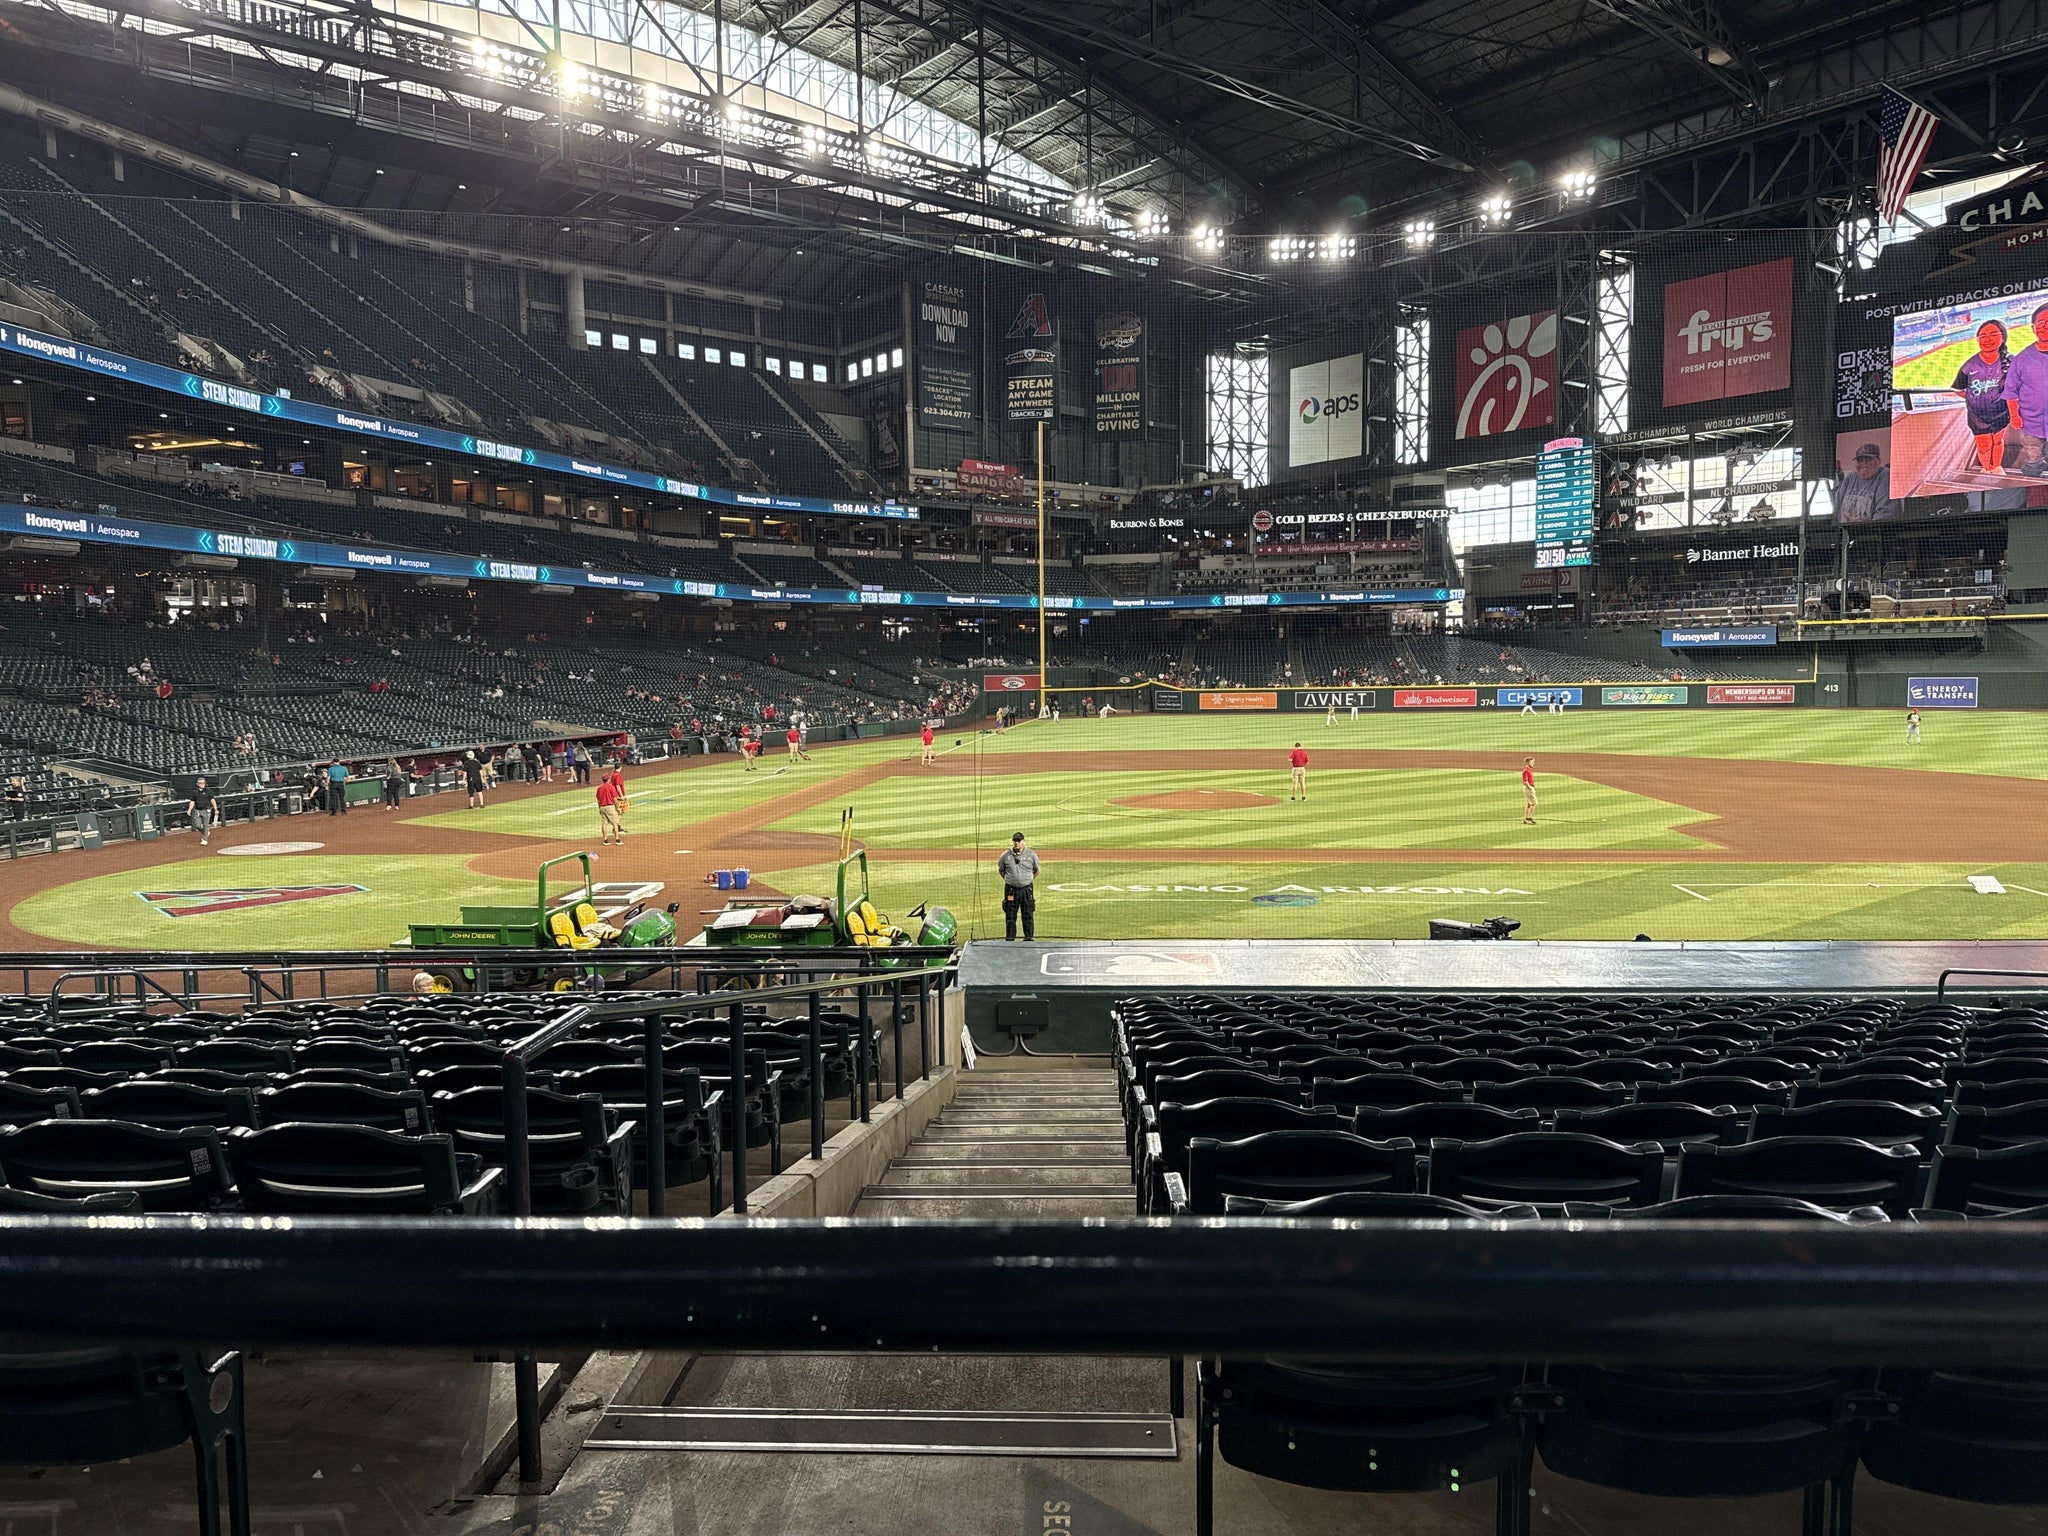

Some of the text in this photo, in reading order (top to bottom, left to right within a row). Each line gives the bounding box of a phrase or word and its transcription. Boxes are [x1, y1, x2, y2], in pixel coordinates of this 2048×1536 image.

[925, 282, 965, 298] CAESARS
[1866, 305, 1898, 320] POST
[1901, 299, 1932, 313] WITH
[1936, 287, 1999, 306] #DBACKS
[2003, 282, 2023, 294] ON
[922, 303, 969, 328] DOWNLOAD
[1701, 313, 1767, 331] FOOD STORES
[935, 324, 956, 343] NOW
[16, 332, 127, 373] Honeywell Aerospace
[1096, 357, 1140, 365] CELEBRATING
[1680, 352, 1771, 374] FRESH FOR EVERYONE
[1008, 379, 1053, 390] STREAM
[202, 380, 261, 412] STEM SUNDAY
[933, 394, 962, 402] LOCATION
[1008, 390, 1053, 400] ANY GAME
[1096, 392, 1140, 403] MILLION
[1008, 400, 1053, 408] ANYWHERE
[1323, 393, 1359, 418] aps
[923, 407, 971, 418] 623.304.0777
[1096, 411, 1140, 420] CHARITABLE
[337, 414, 419, 439] Honeywell Aerospace
[1096, 420, 1140, 431] GIVING
[1705, 411, 1787, 430] WORLD CHAMPIONS
[1603, 426, 1687, 444] NL WEST CHAMPIONS
[477, 440, 522, 462] STEM SUNDAY
[572, 461, 601, 475] Honeywell
[976, 463, 1005, 471] Honeywell
[1711, 482, 1778, 497] NL CHAMPIONS
[737, 494, 771, 505] Honeywell
[1620, 495, 1664, 507] WILD CARD
[833, 503, 869, 514] 11:06 AM
[1023, 518, 1037, 526] SEATS
[1149, 518, 1157, 527] &
[1275, 515, 1305, 524] COLD
[1308, 513, 1344, 523] BEERS
[1347, 513, 1354, 521] &
[1356, 509, 1456, 521] CHEESEBURGERS
[26, 513, 140, 538] Honeywell Aerospace
[218, 534, 278, 558] STEM SUNDAY
[1702, 542, 1799, 561] Banner Health
[348, 552, 430, 568] Honeywell Aerospace
[490, 563, 537, 580] STEM SUNDAY
[588, 573, 618, 585] Honeywell
[684, 581, 698, 594] STEM
[751, 590, 781, 599] Honeywell
[860, 592, 901, 604] STEM SUNDAY
[947, 596, 975, 604] Honeywell
[1224, 594, 1269, 606] STEM SUNDAY
[1330, 592, 1364, 601] Honeywell
[1043, 597, 1055, 607] TEM
[1112, 599, 1145, 607] Honeywell
[1672, 632, 1766, 644] Honeywell Aerospace
[1926, 685, 1965, 693] ENERGY
[1225, 696, 1244, 704] Dignity
[1304, 693, 1366, 707] AVNET
[1425, 696, 1470, 704] Budweiser
[1480, 698, 1495, 706] 374
[1623, 693, 1645, 701] Baja
[1926, 692, 1974, 700] TRANSFER
[1047, 883, 1538, 895] CASINO ARIZONA
[471, 932, 496, 940] DEERE
